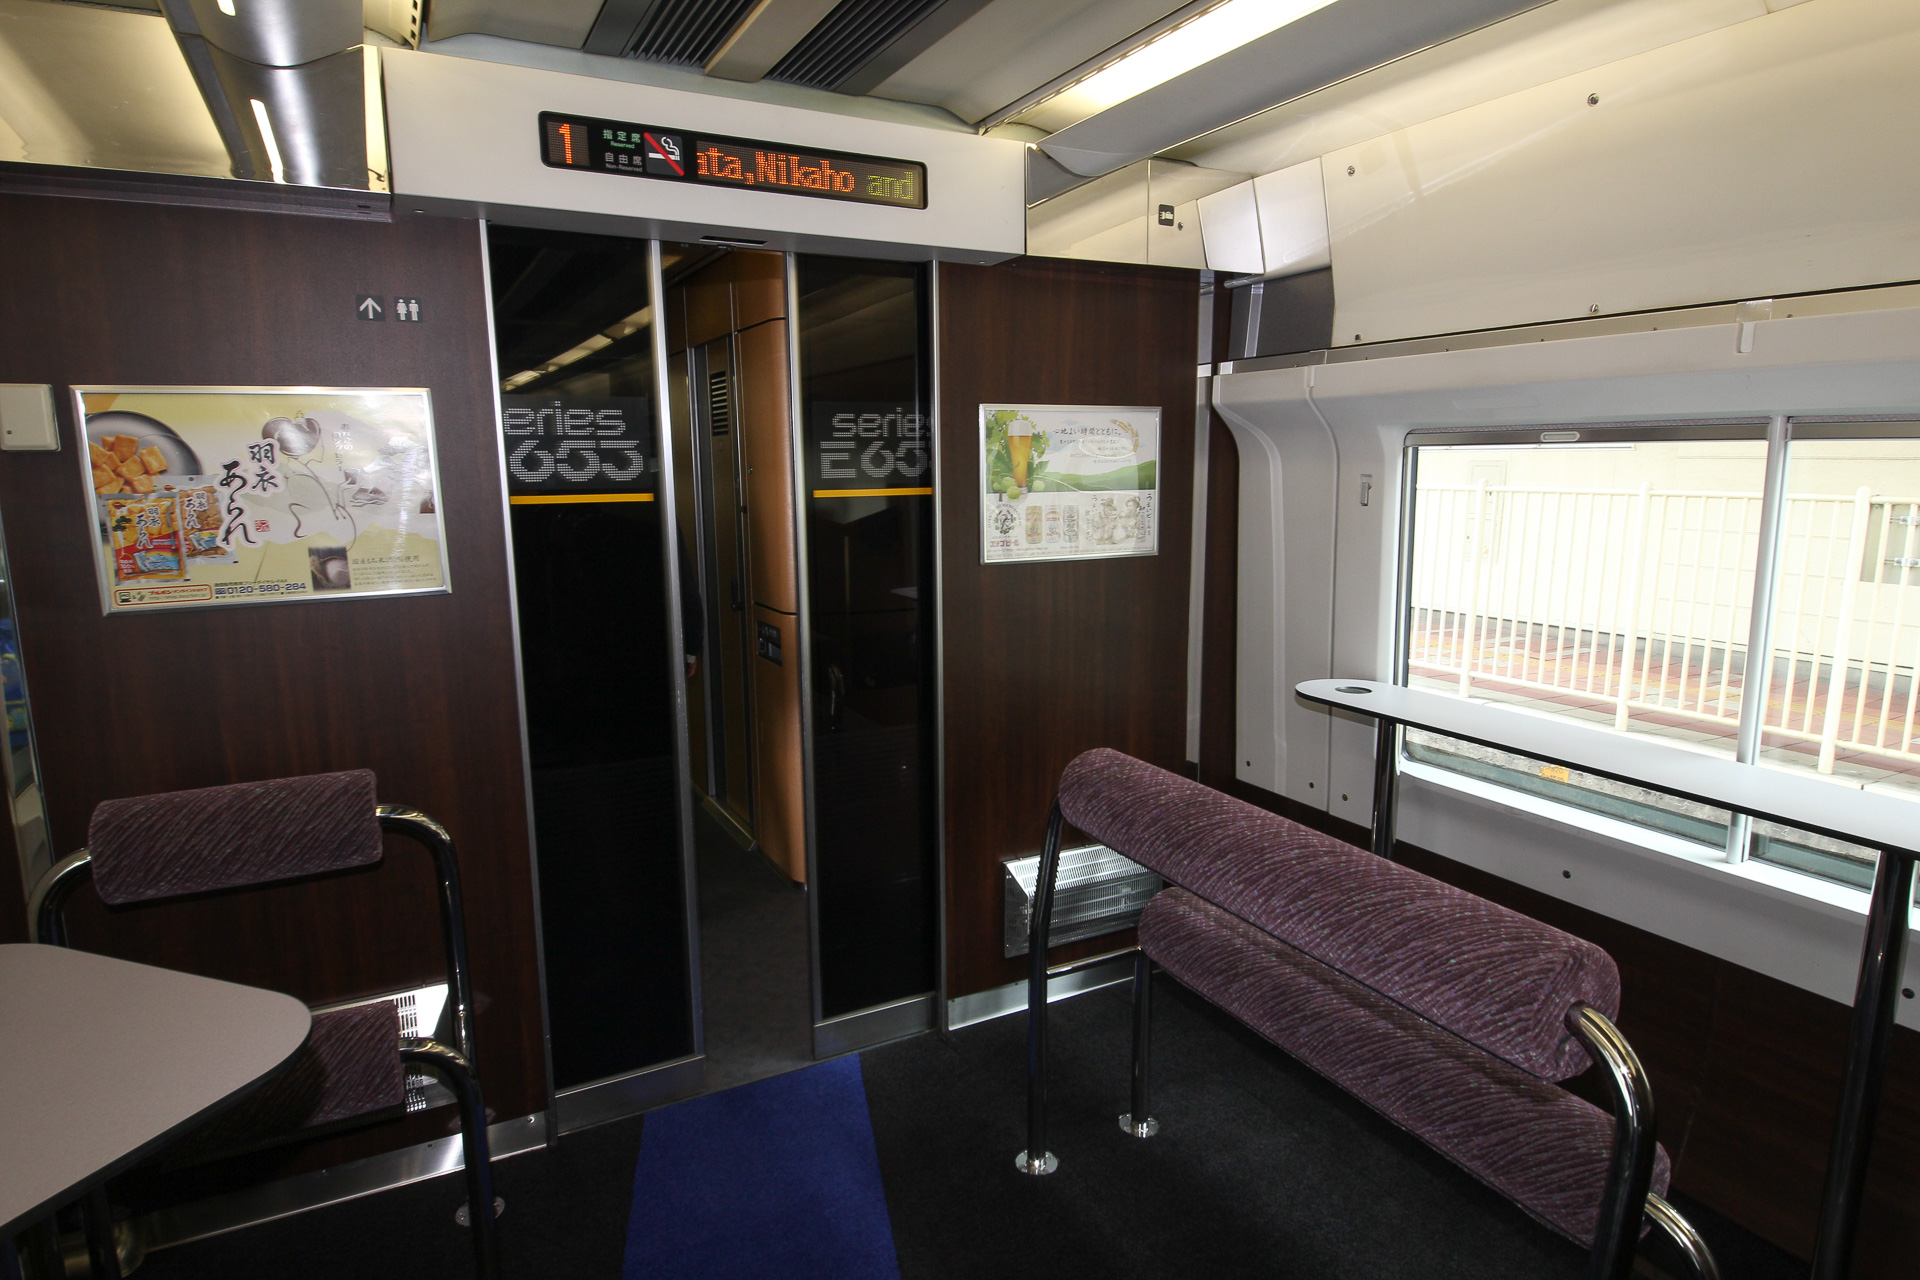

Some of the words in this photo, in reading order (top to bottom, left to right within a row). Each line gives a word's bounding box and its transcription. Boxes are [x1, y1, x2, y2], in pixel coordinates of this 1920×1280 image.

[603, 129, 641, 143] 指定席
[558, 123, 573, 164] 1
[610, 141, 635, 149] Reserved
[605, 152, 642, 165] 自由席
[605, 163, 643, 172] Non-Reserved
[867, 171, 914, 200] and
[820, 440, 932, 478] E65
[220, 461, 257, 545] あられ
[227, 582, 306, 594] 0120-580-284
